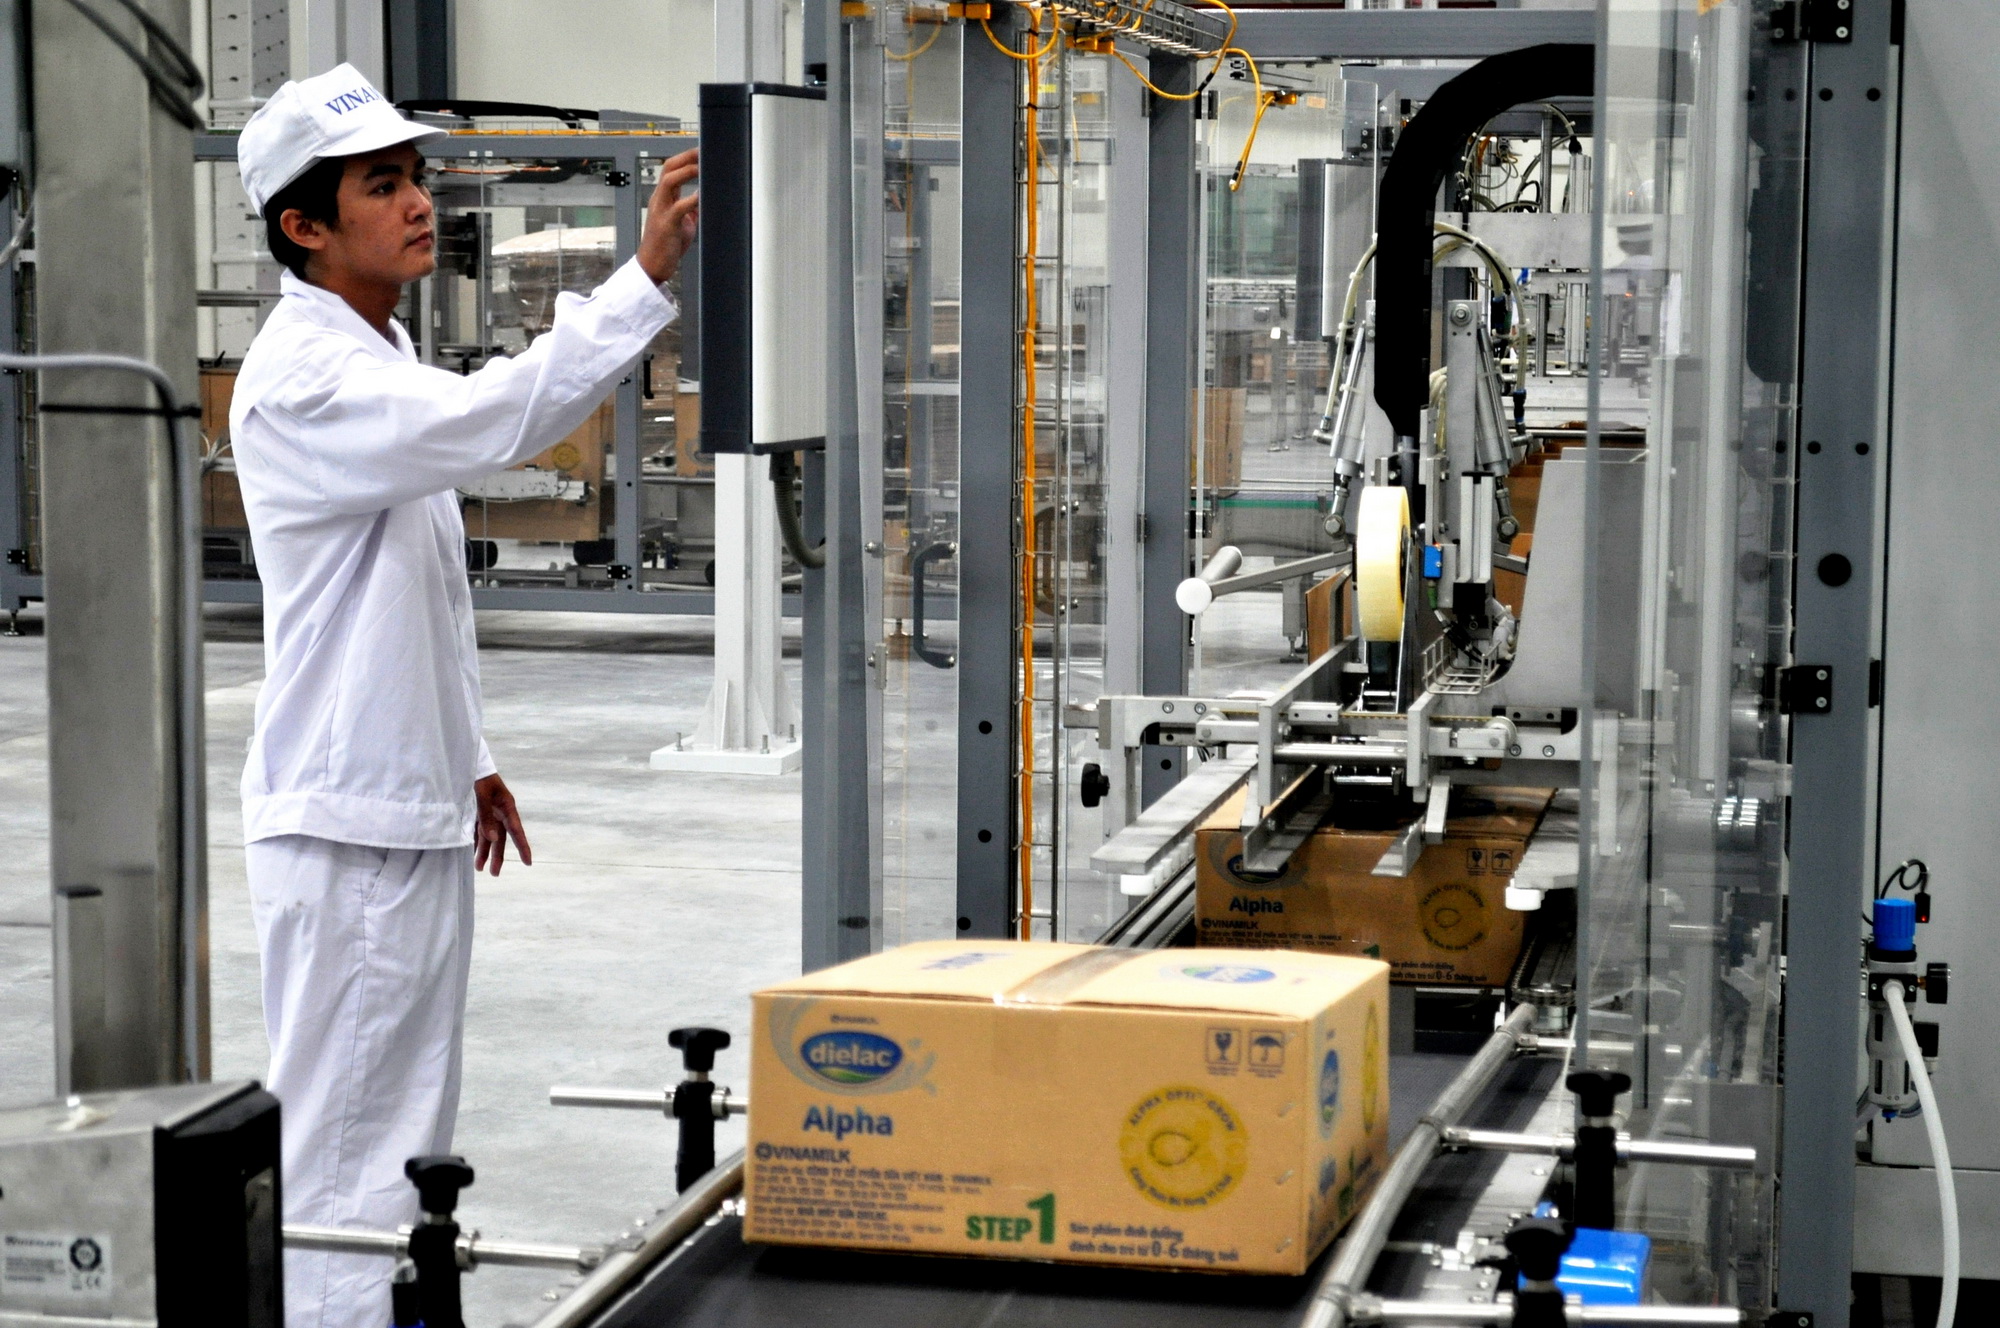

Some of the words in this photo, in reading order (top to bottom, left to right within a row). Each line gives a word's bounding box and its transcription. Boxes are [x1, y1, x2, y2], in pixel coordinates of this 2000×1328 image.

[1228, 896, 1284, 916] Alpha
[1212, 919, 1258, 930] VINAMILK
[809, 1042, 893, 1067] dielac
[802, 1105, 893, 1141] Alpha
[773, 1146, 851, 1163] VINAMILK
[966, 1215, 1033, 1242] STEP
[1027, 1193, 1055, 1244] 1
